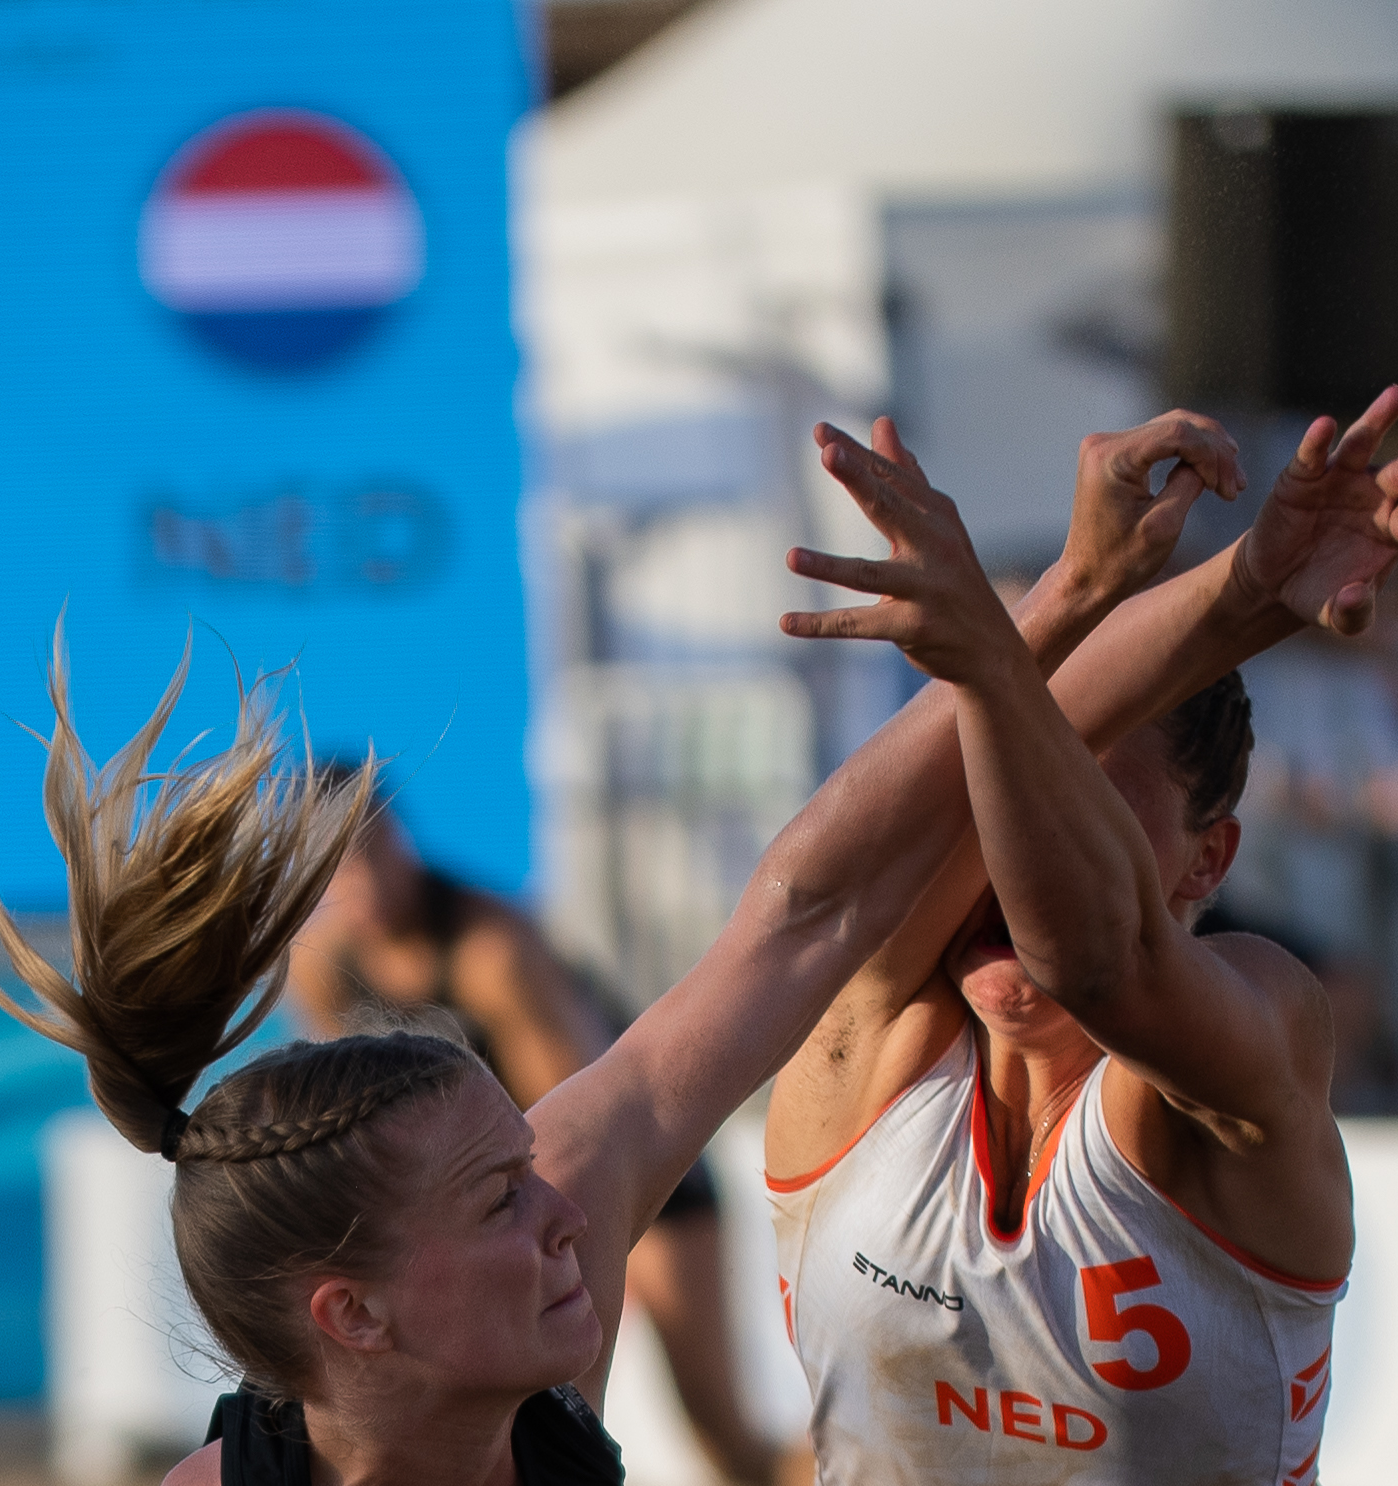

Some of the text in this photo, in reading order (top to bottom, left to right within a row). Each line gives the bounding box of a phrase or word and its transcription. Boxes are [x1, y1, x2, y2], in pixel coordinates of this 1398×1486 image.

[133, 474, 455, 606] NED
[1079, 1254, 1192, 1392] 5
[935, 1379, 1109, 1452] NED
